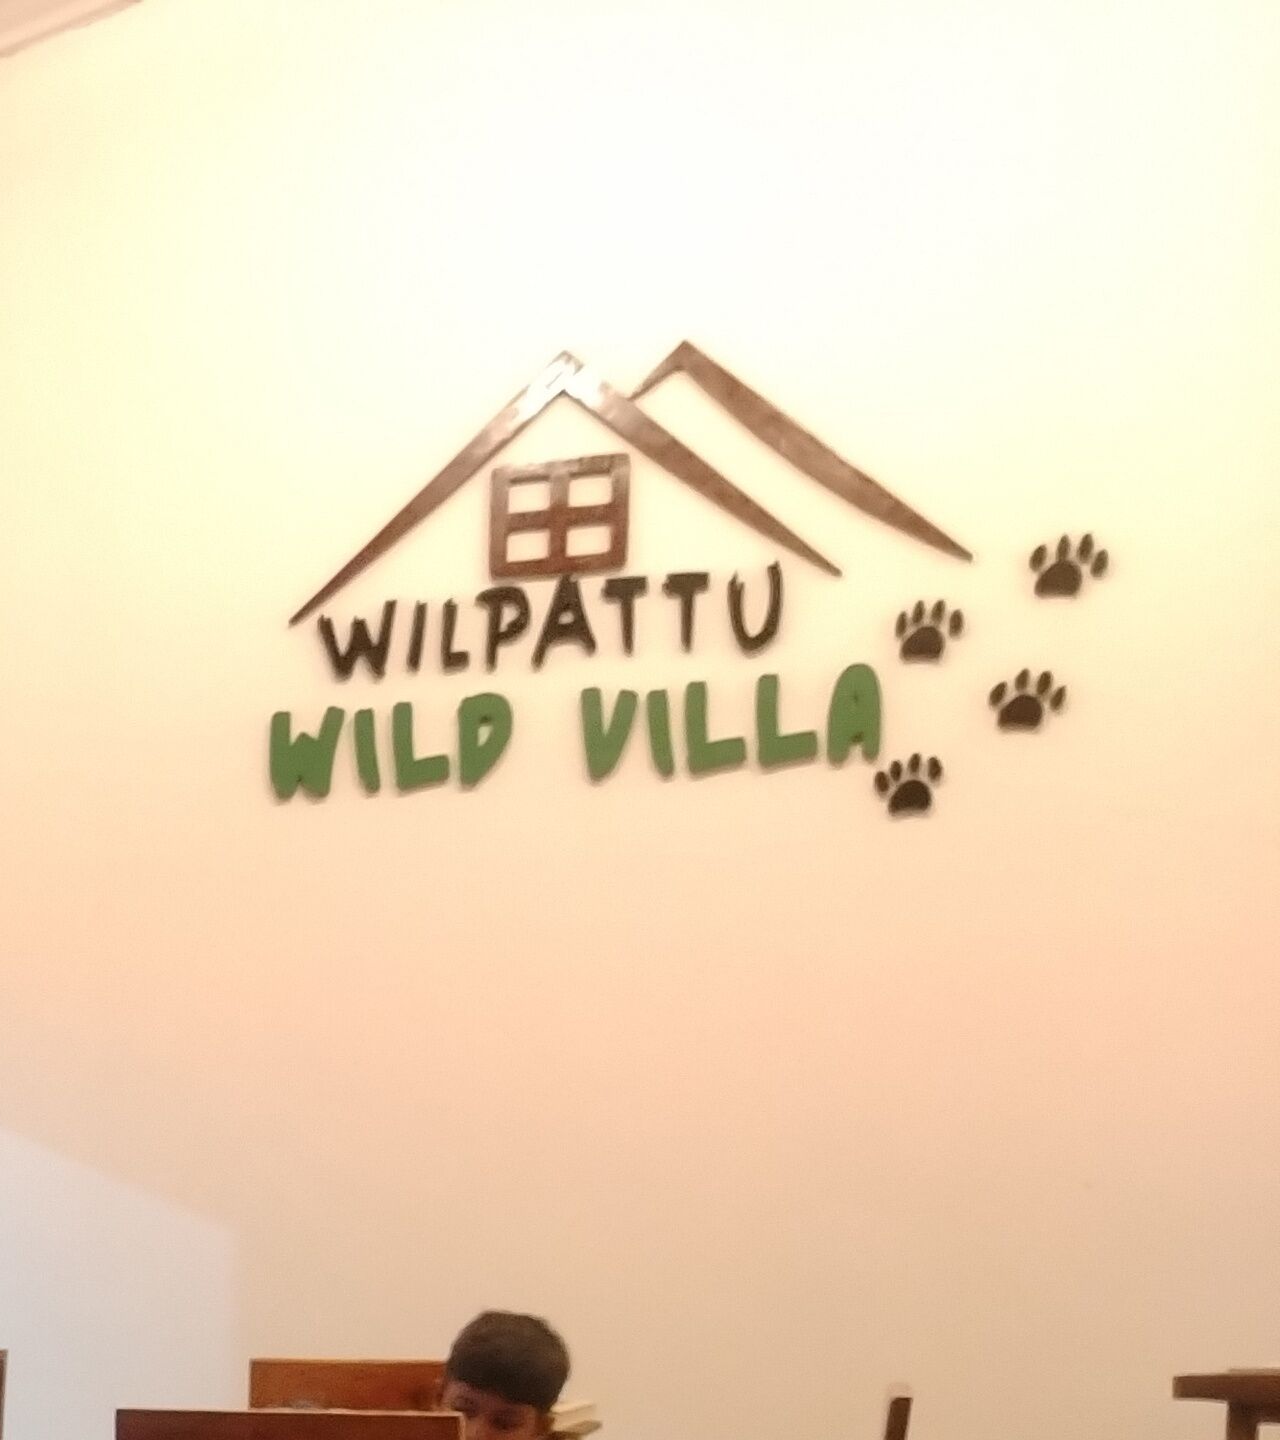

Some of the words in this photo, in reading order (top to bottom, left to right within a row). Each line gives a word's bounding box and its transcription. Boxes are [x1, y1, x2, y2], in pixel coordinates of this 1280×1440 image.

[318, 562, 782, 681] WILPATTU
[269, 693, 513, 801] WILD
[581, 663, 882, 781] VILLA
